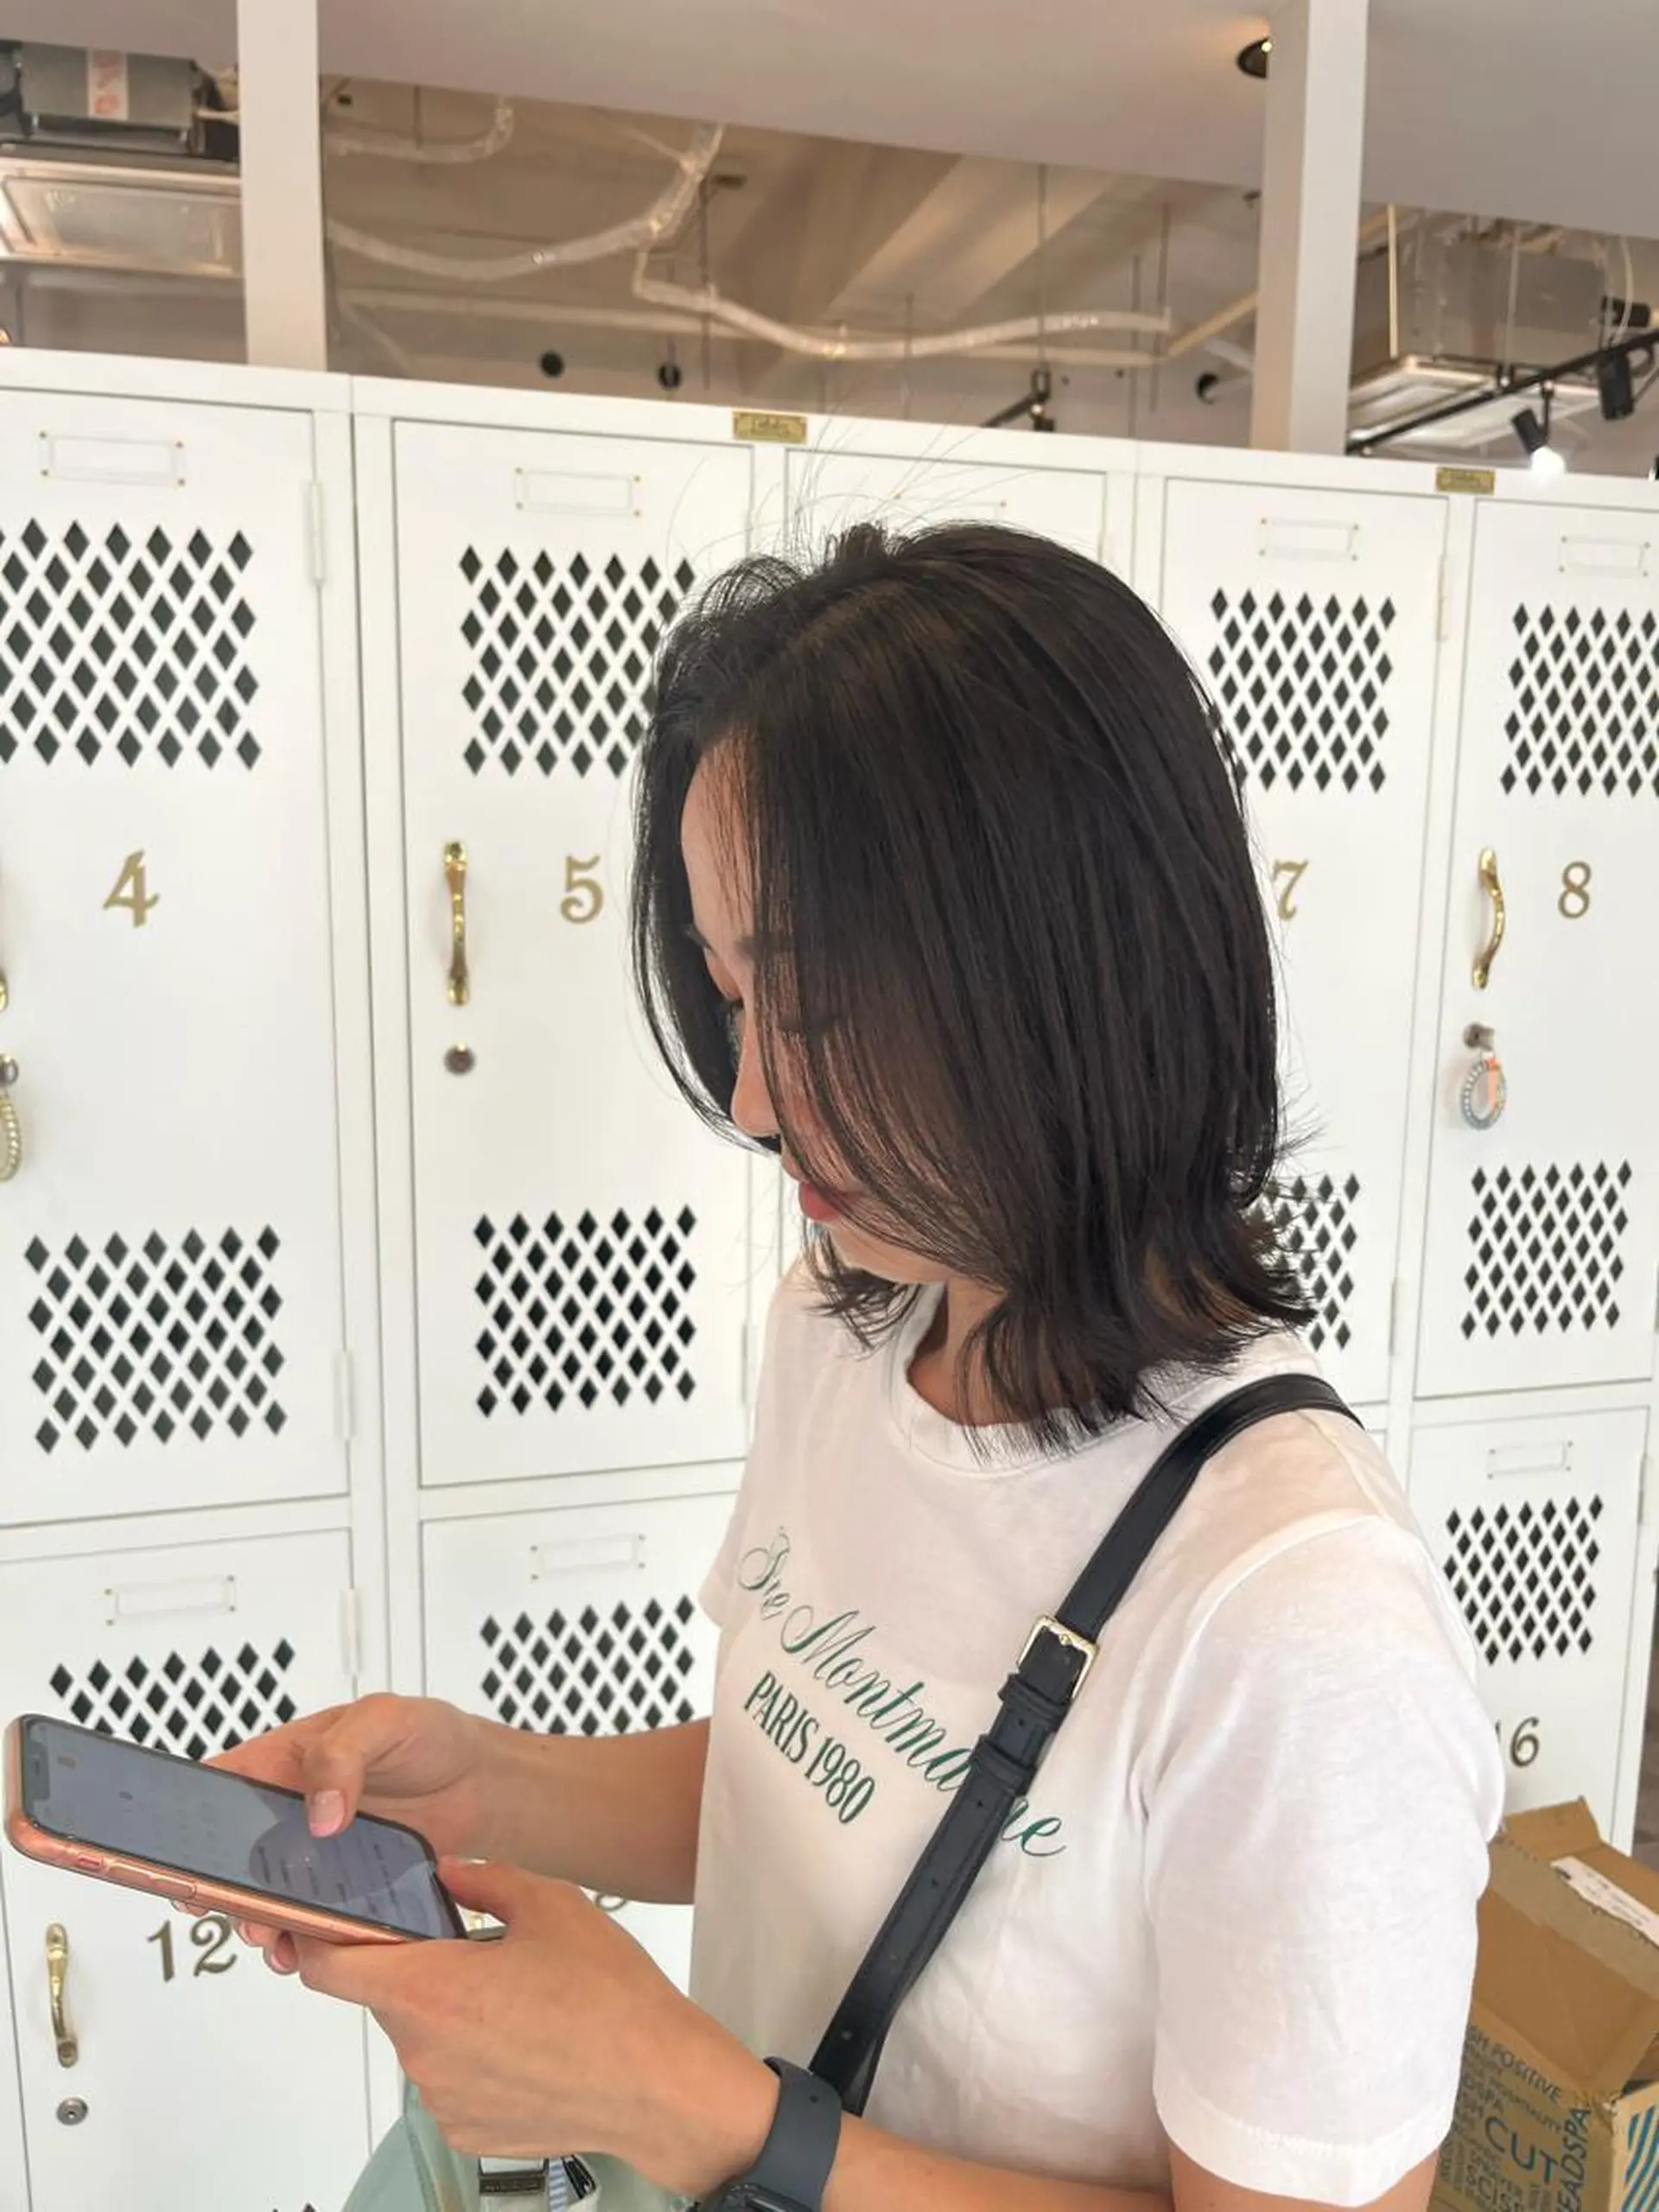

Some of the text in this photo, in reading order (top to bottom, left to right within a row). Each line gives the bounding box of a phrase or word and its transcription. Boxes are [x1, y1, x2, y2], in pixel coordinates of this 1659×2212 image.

[103, 849, 161, 928] 4
[560, 855, 604, 925] 5
[1273, 859, 1309, 921] 7
[1558, 861, 1592, 919] 8
[743, 1670, 876, 1825] PARIS 1980
[147, 1914, 238, 1983] 12
[1484, 2116, 1559, 2185] CUT
[1557, 2107, 1591, 2212] EADSPA
